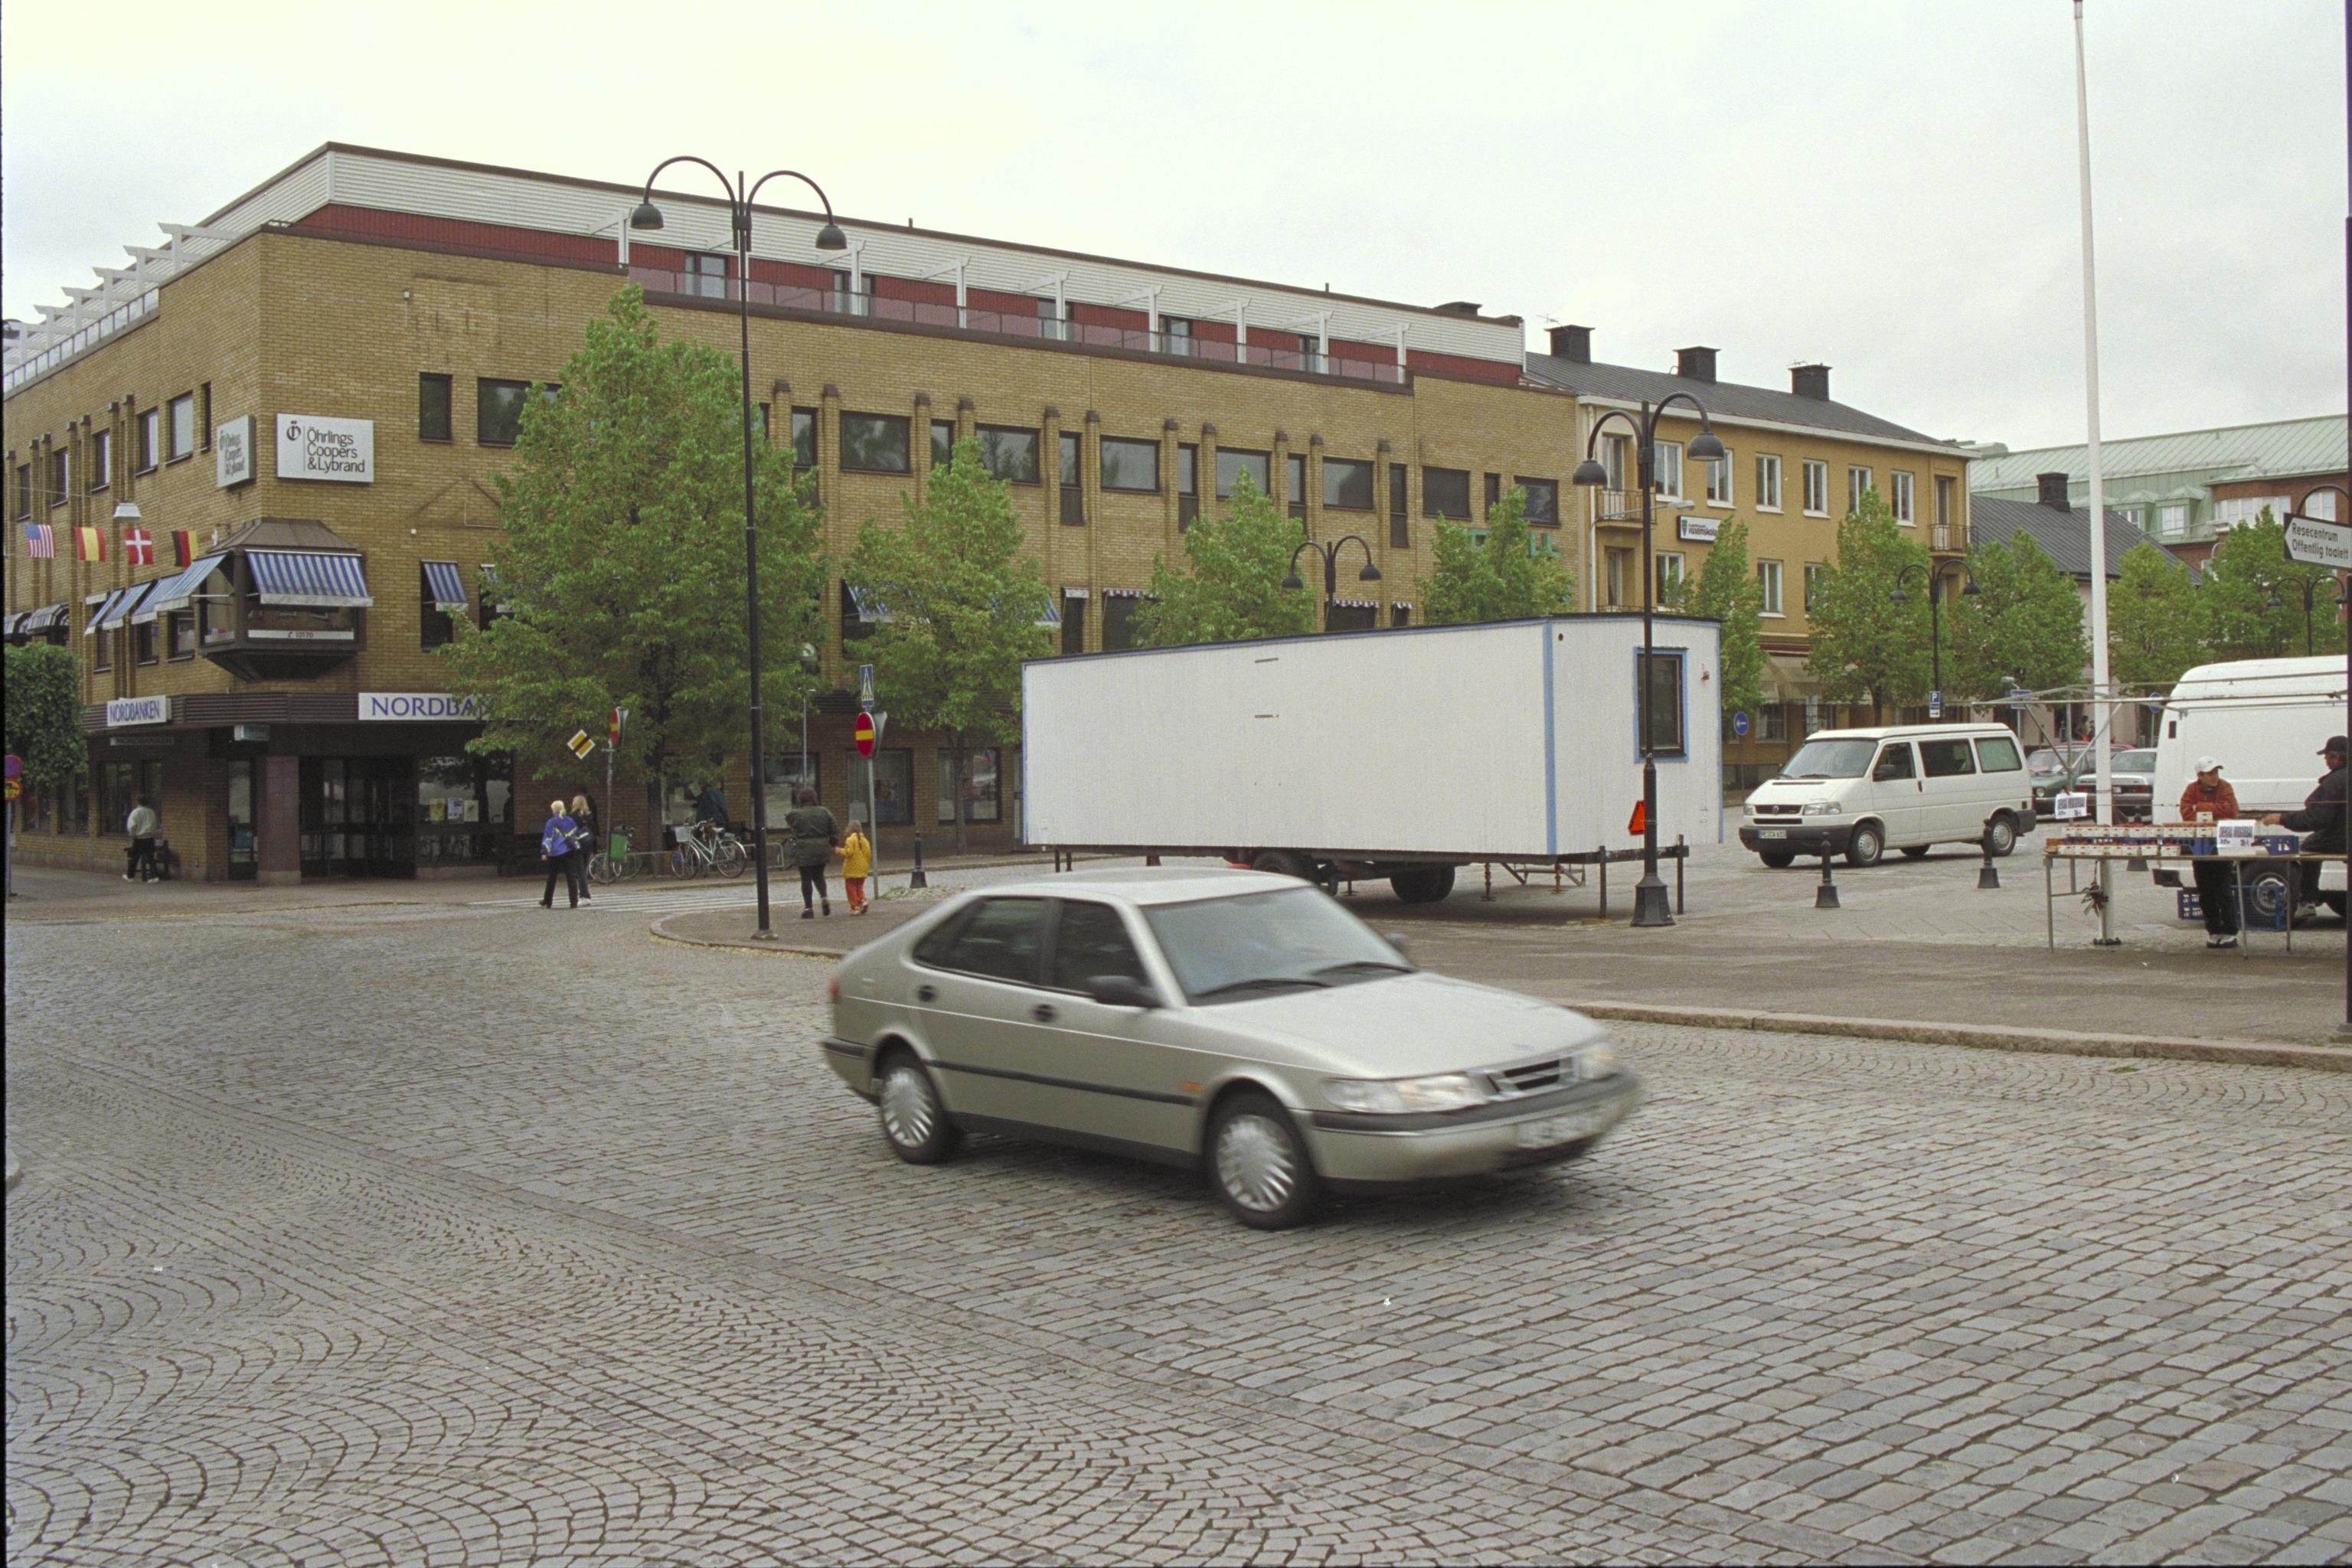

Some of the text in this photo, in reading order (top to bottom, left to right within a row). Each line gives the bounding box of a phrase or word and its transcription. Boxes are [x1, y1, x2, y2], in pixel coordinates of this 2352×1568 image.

[307, 426, 354, 447] Öhrlings
[307, 443, 358, 462] Coopers
[2292, 522, 2338, 542] Resecentrum
[2292, 538, 2349, 560] Offentlig toalett
[109, 699, 160, 723] NORDBANKEN
